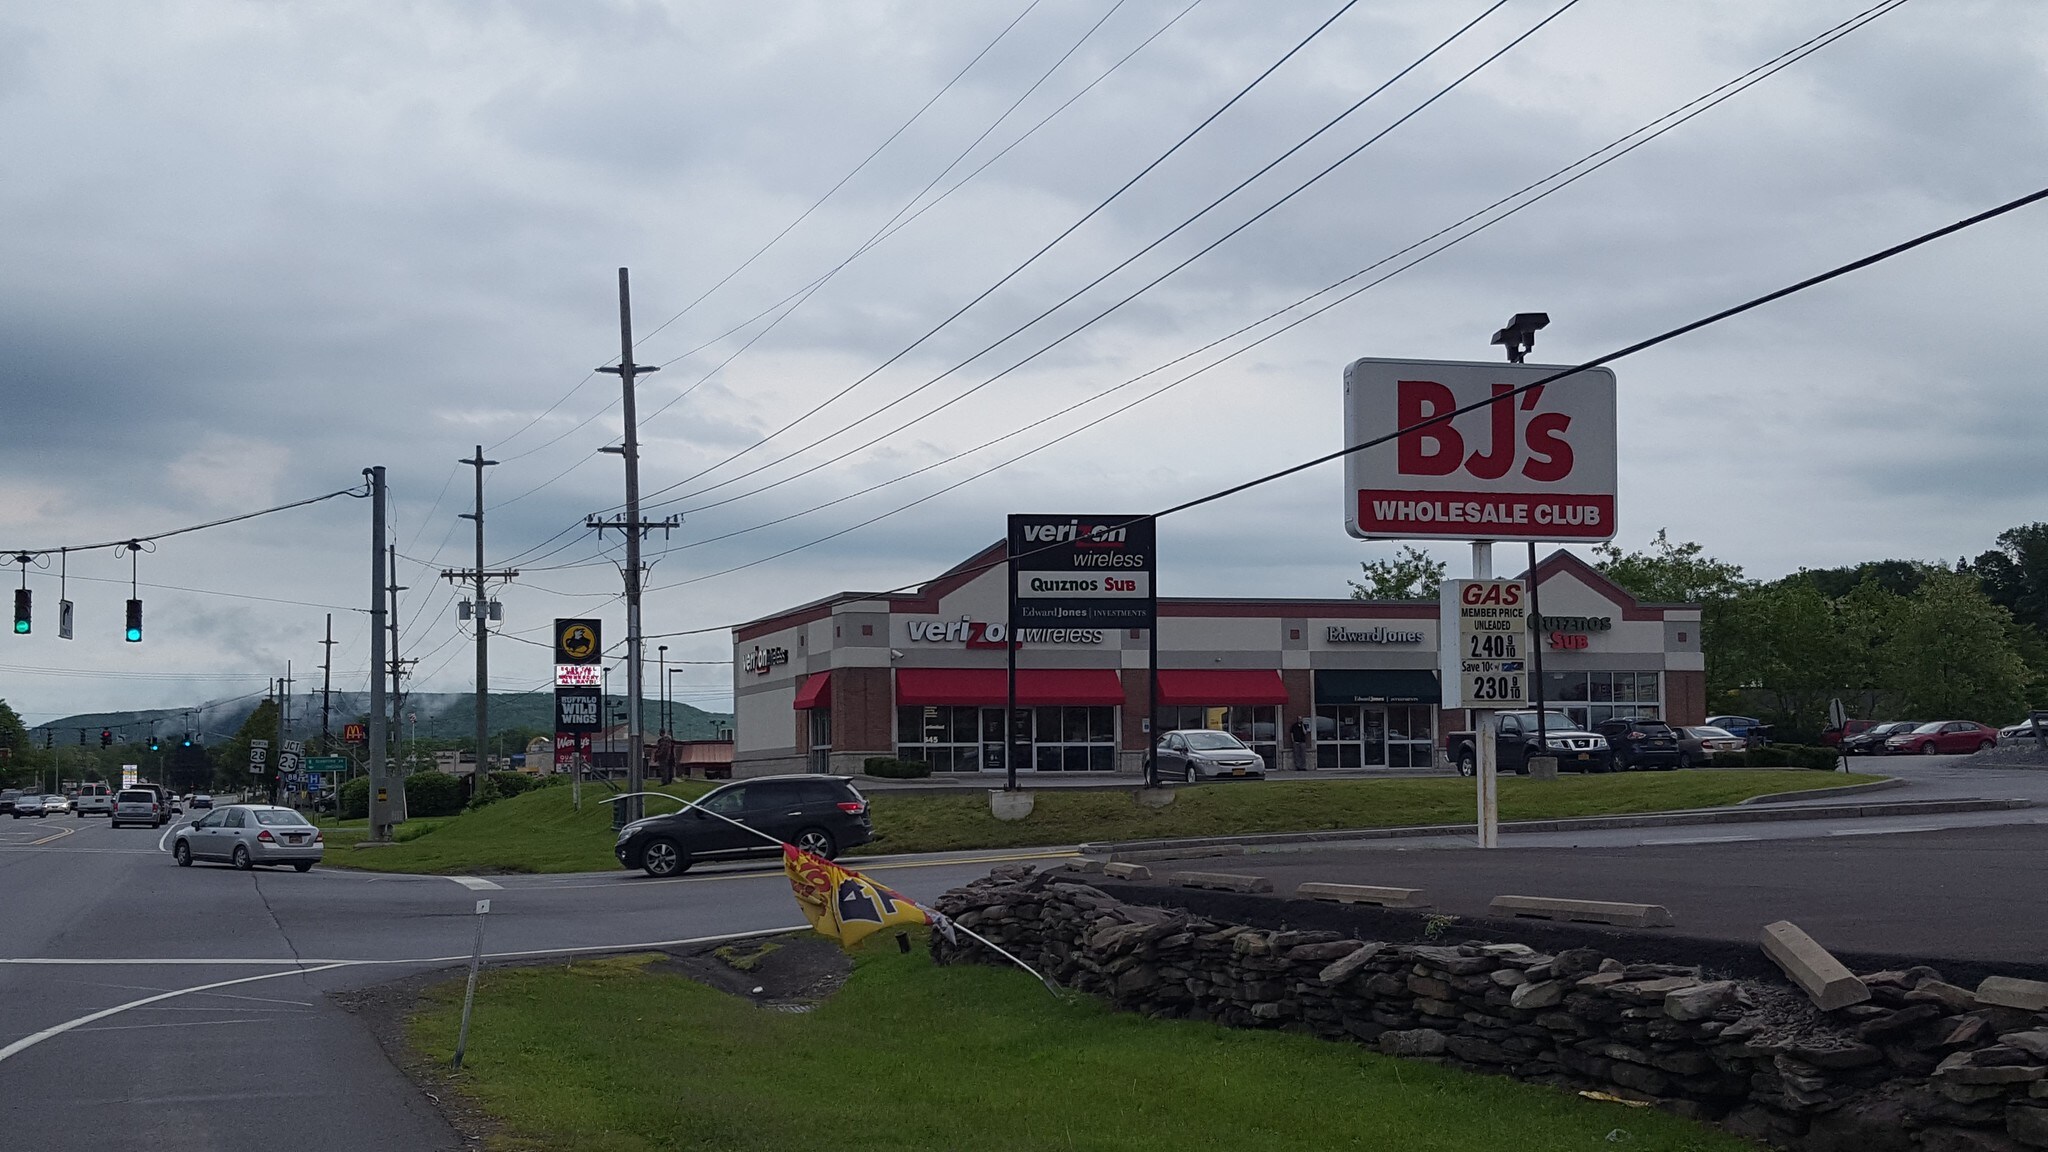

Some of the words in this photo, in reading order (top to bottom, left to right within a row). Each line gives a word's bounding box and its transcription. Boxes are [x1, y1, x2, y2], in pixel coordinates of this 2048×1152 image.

[1398, 380, 1574, 482] BJ's
[1373, 501, 1528, 524] WHOLESALE
[1534, 505, 1600, 526] CLUB
[1024, 519, 1126, 547] verizon
[1073, 550, 1143, 567] wireless
[1462, 583, 1521, 605] GAS
[1461, 608, 1498, 618] MEMBER
[1500, 608, 1524, 618] PRICE
[1474, 620, 1511, 631] UNLEADED
[1471, 635, 1503, 658] 2.40
[1461, 661, 1480, 672] Save
[1474, 676, 1508, 699] 230
[561, 696, 597, 704] BUFFALO
[562, 703, 597, 715] WILD
[561, 714, 597, 724] WINGS
[284, 741, 300, 751] JCT
[557, 736, 590, 749] Weny's
[251, 751, 265, 760] 28
[279, 756, 297, 769] 23
[310, 774, 318, 784] H
